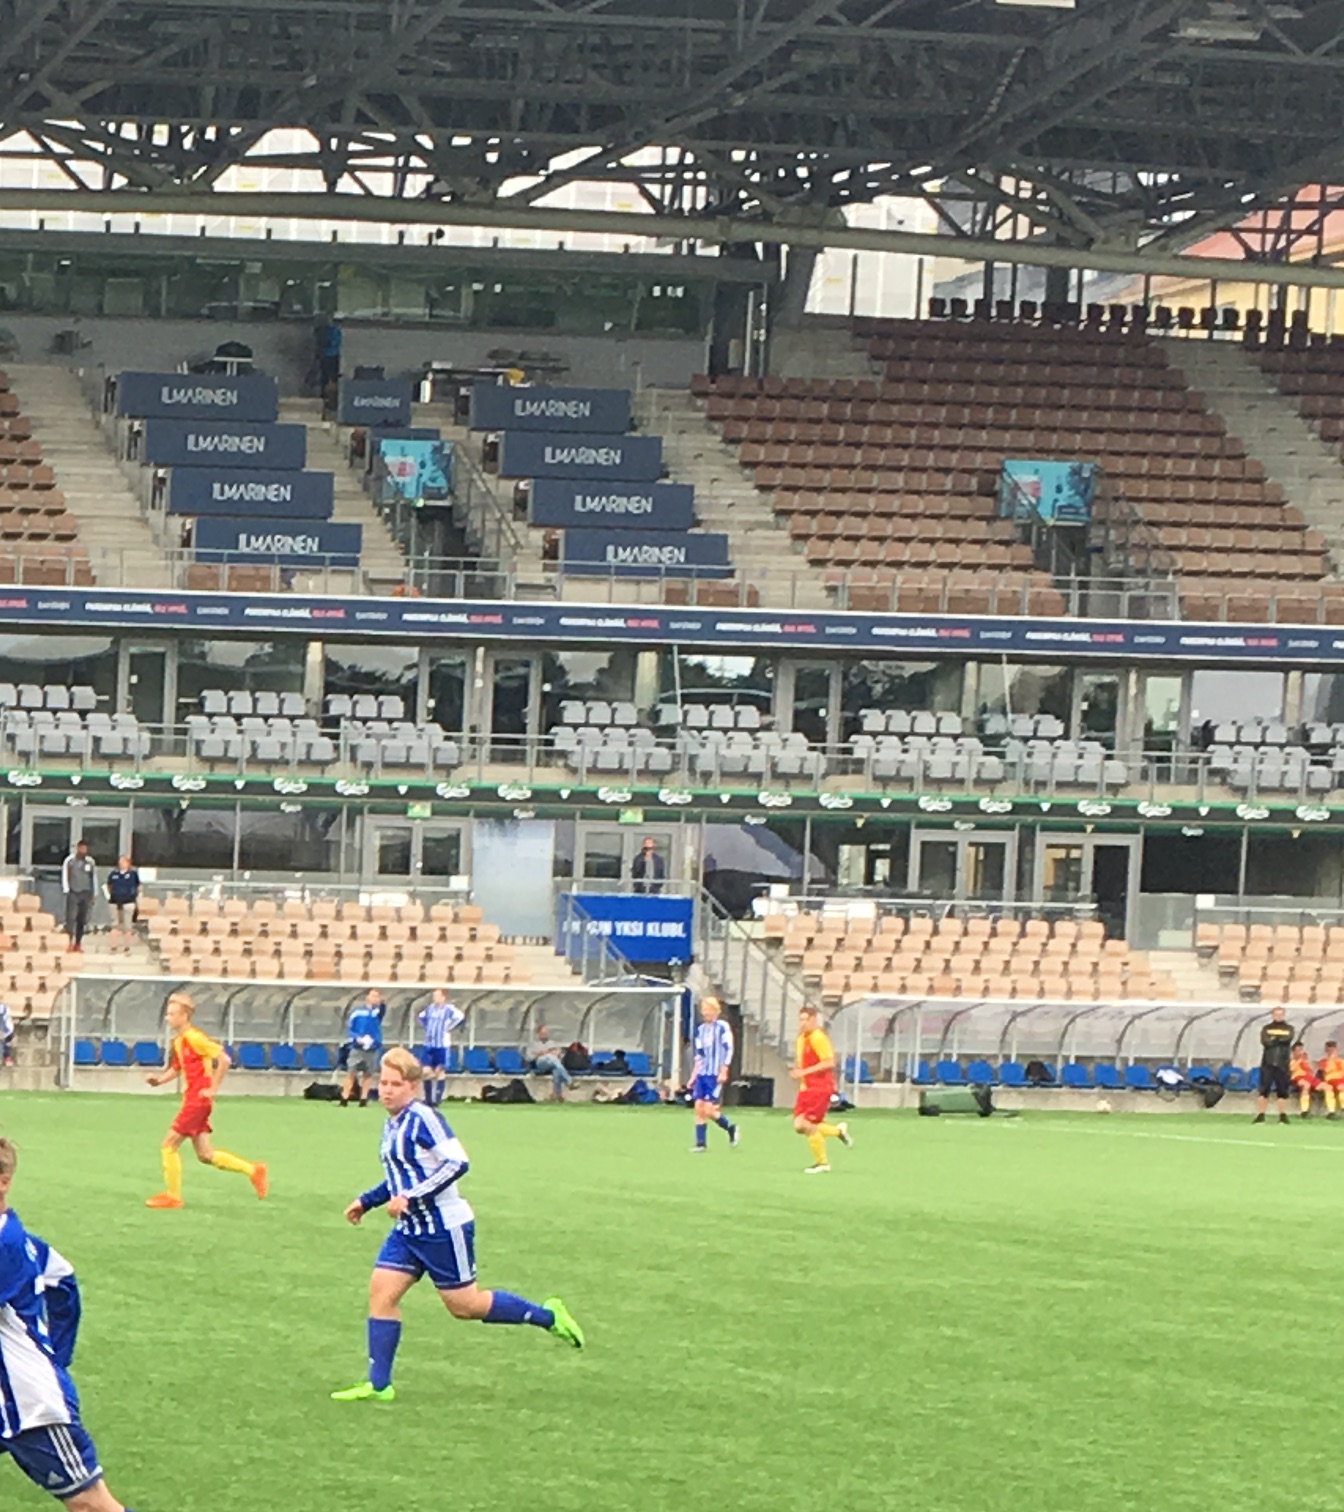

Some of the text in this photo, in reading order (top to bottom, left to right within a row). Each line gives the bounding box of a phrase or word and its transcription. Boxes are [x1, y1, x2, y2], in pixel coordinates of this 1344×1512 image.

[161, 386, 238, 405] ILMARINEN
[514, 399, 591, 418] ILMARINEN
[187, 434, 265, 454] ILMARINEN
[544, 446, 622, 466] ILMARINEN
[212, 482, 291, 502] ILMARINEN
[574, 495, 653, 514] ILMARINEN
[238, 533, 320, 552] ILMARINEN
[606, 545, 686, 563] ILMARINEN
